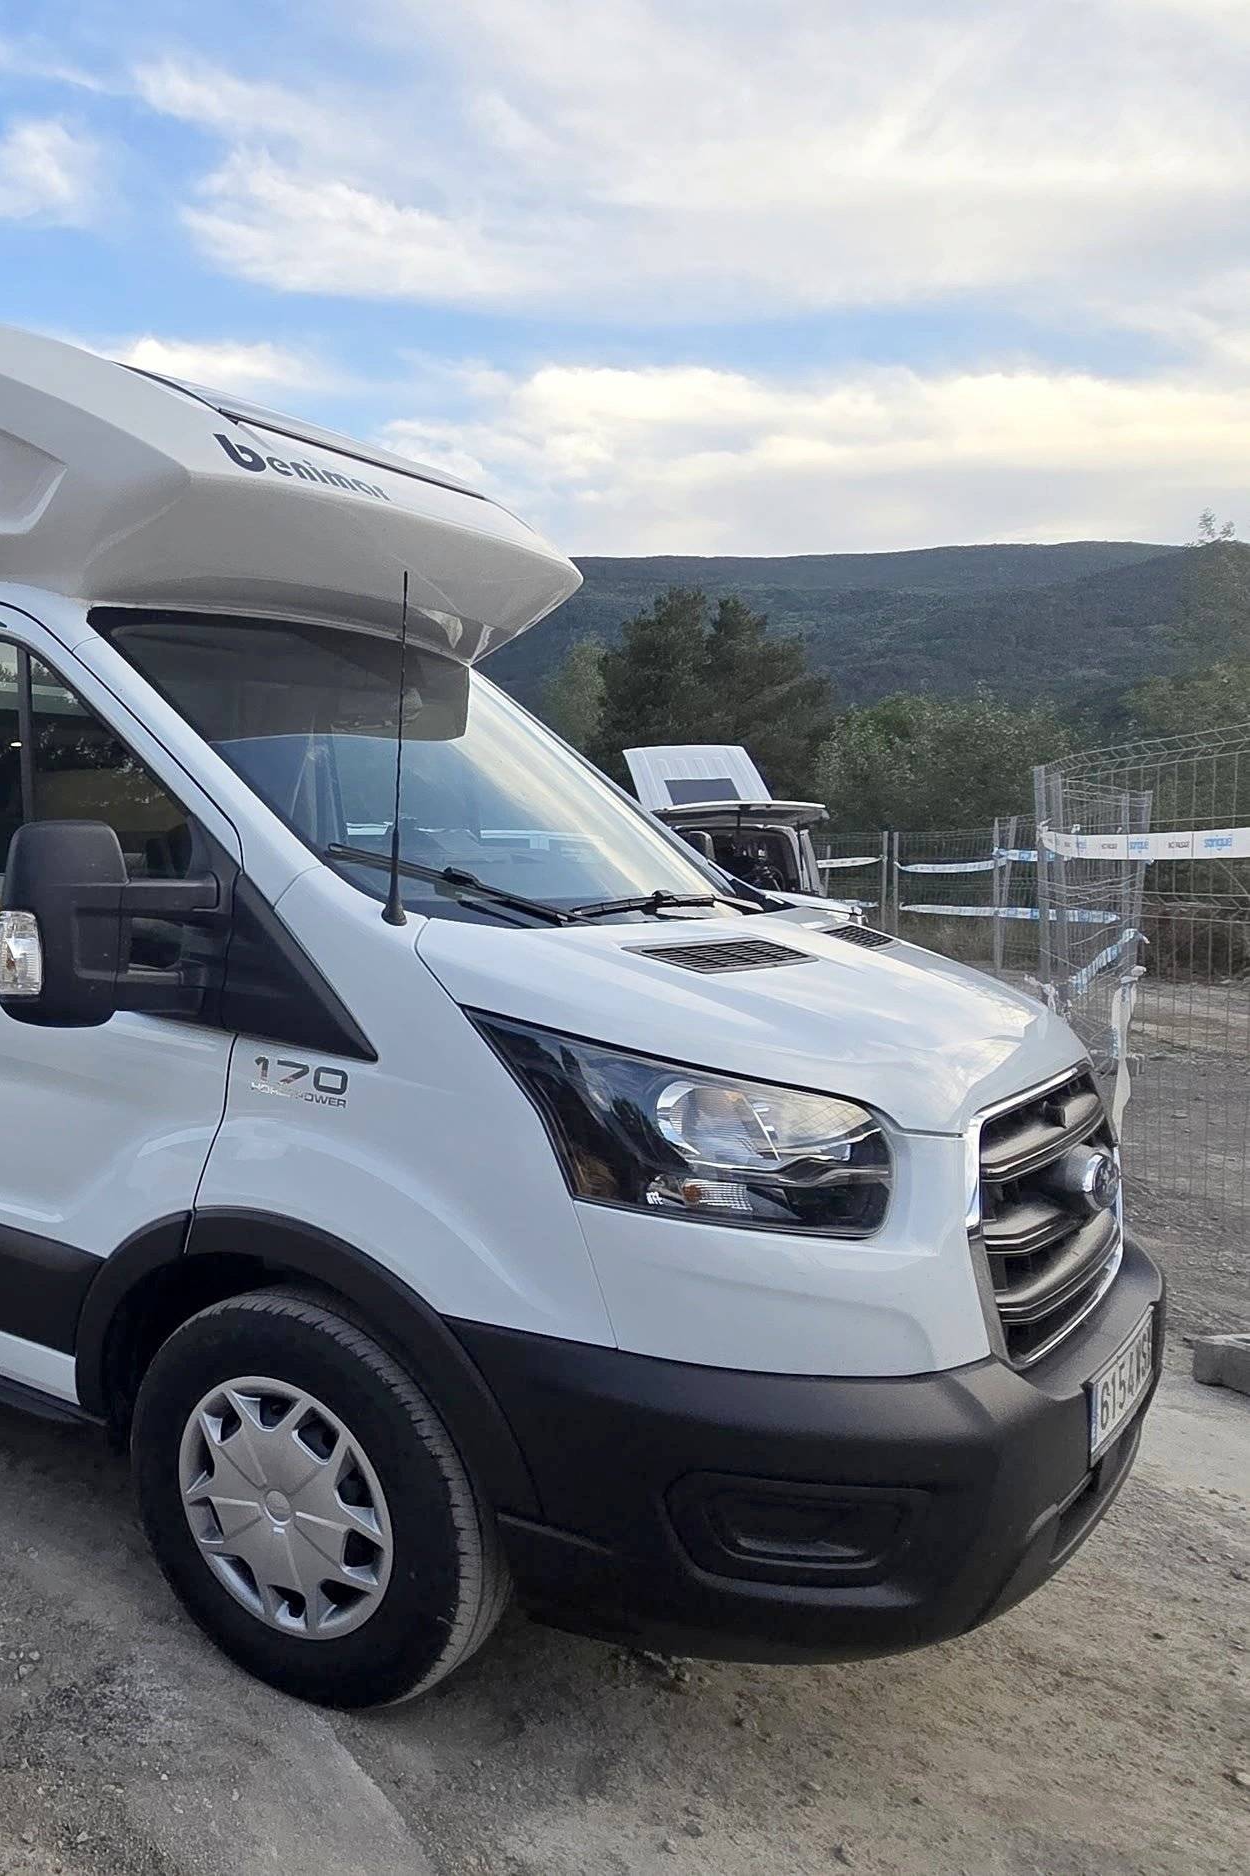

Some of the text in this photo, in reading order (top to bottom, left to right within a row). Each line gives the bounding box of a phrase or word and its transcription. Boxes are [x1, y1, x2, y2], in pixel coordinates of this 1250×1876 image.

[213, 433, 392, 501] benimar
[250, 1081, 347, 1109] HOROWER
[255, 1056, 349, 1096] 170
